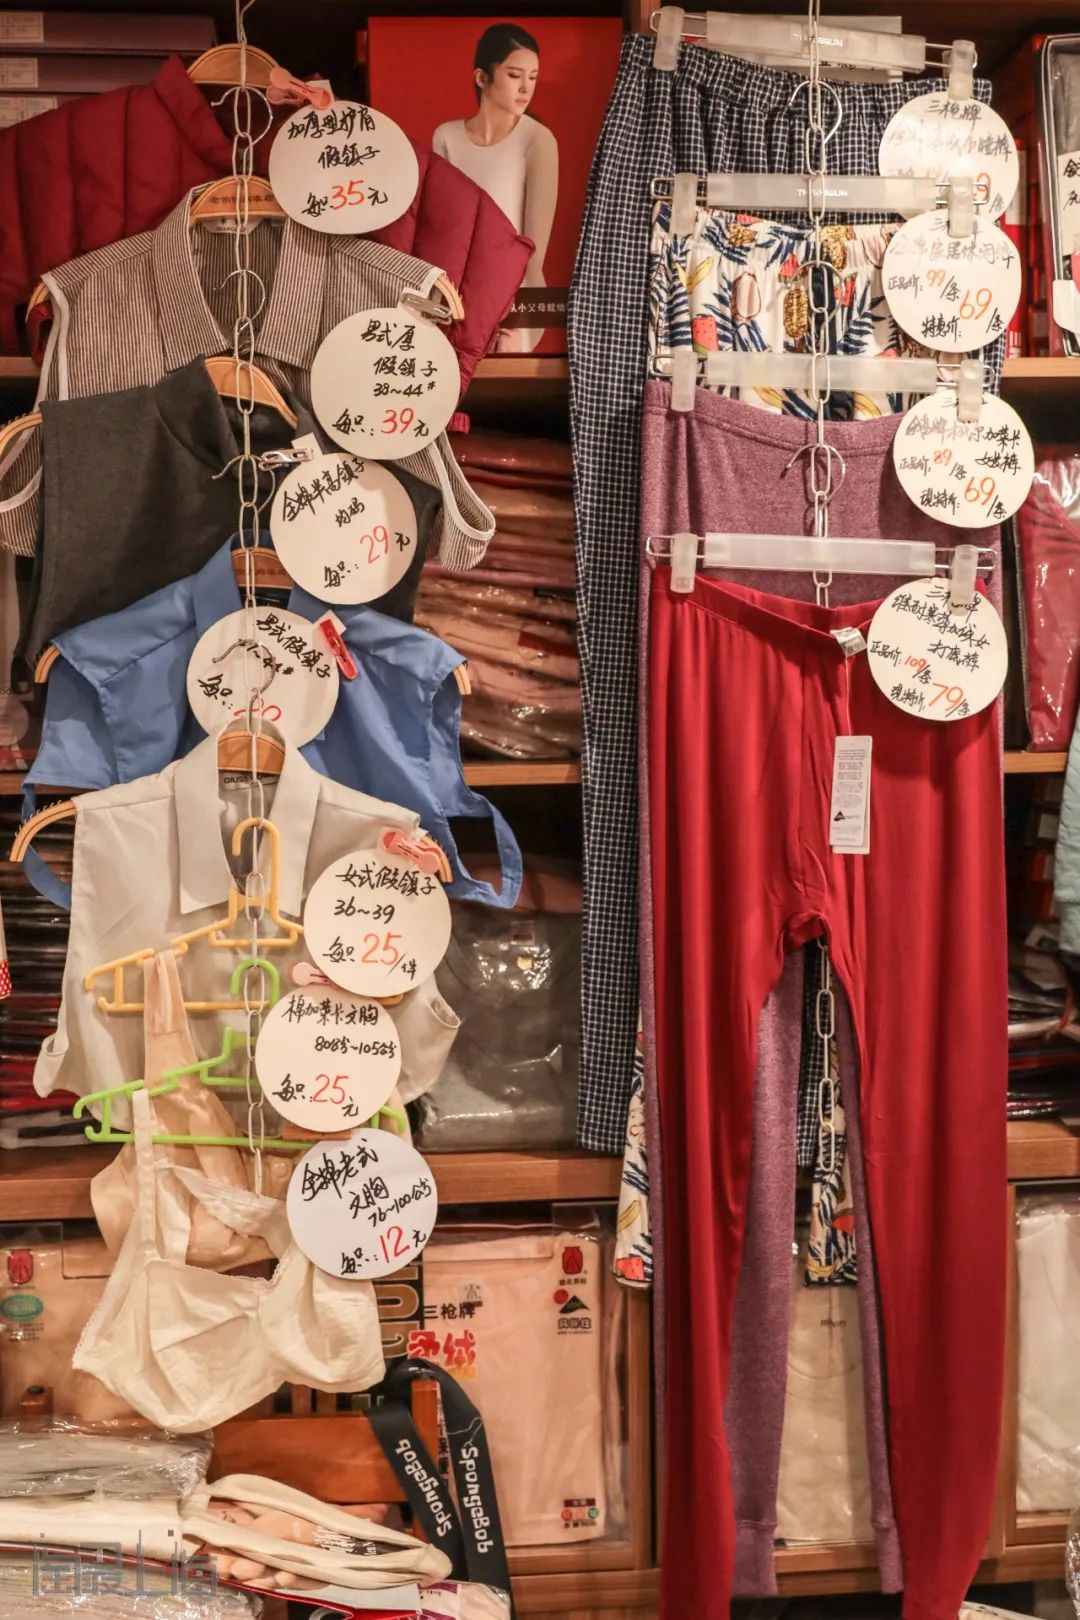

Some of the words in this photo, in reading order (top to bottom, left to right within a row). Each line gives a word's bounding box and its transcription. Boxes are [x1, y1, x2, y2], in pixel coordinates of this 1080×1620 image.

[423, 1303, 476, 1319] 三枪牌
[395, 1439, 453, 1537] SpongeBob
[459, 1446, 494, 1553] SpongeBob
